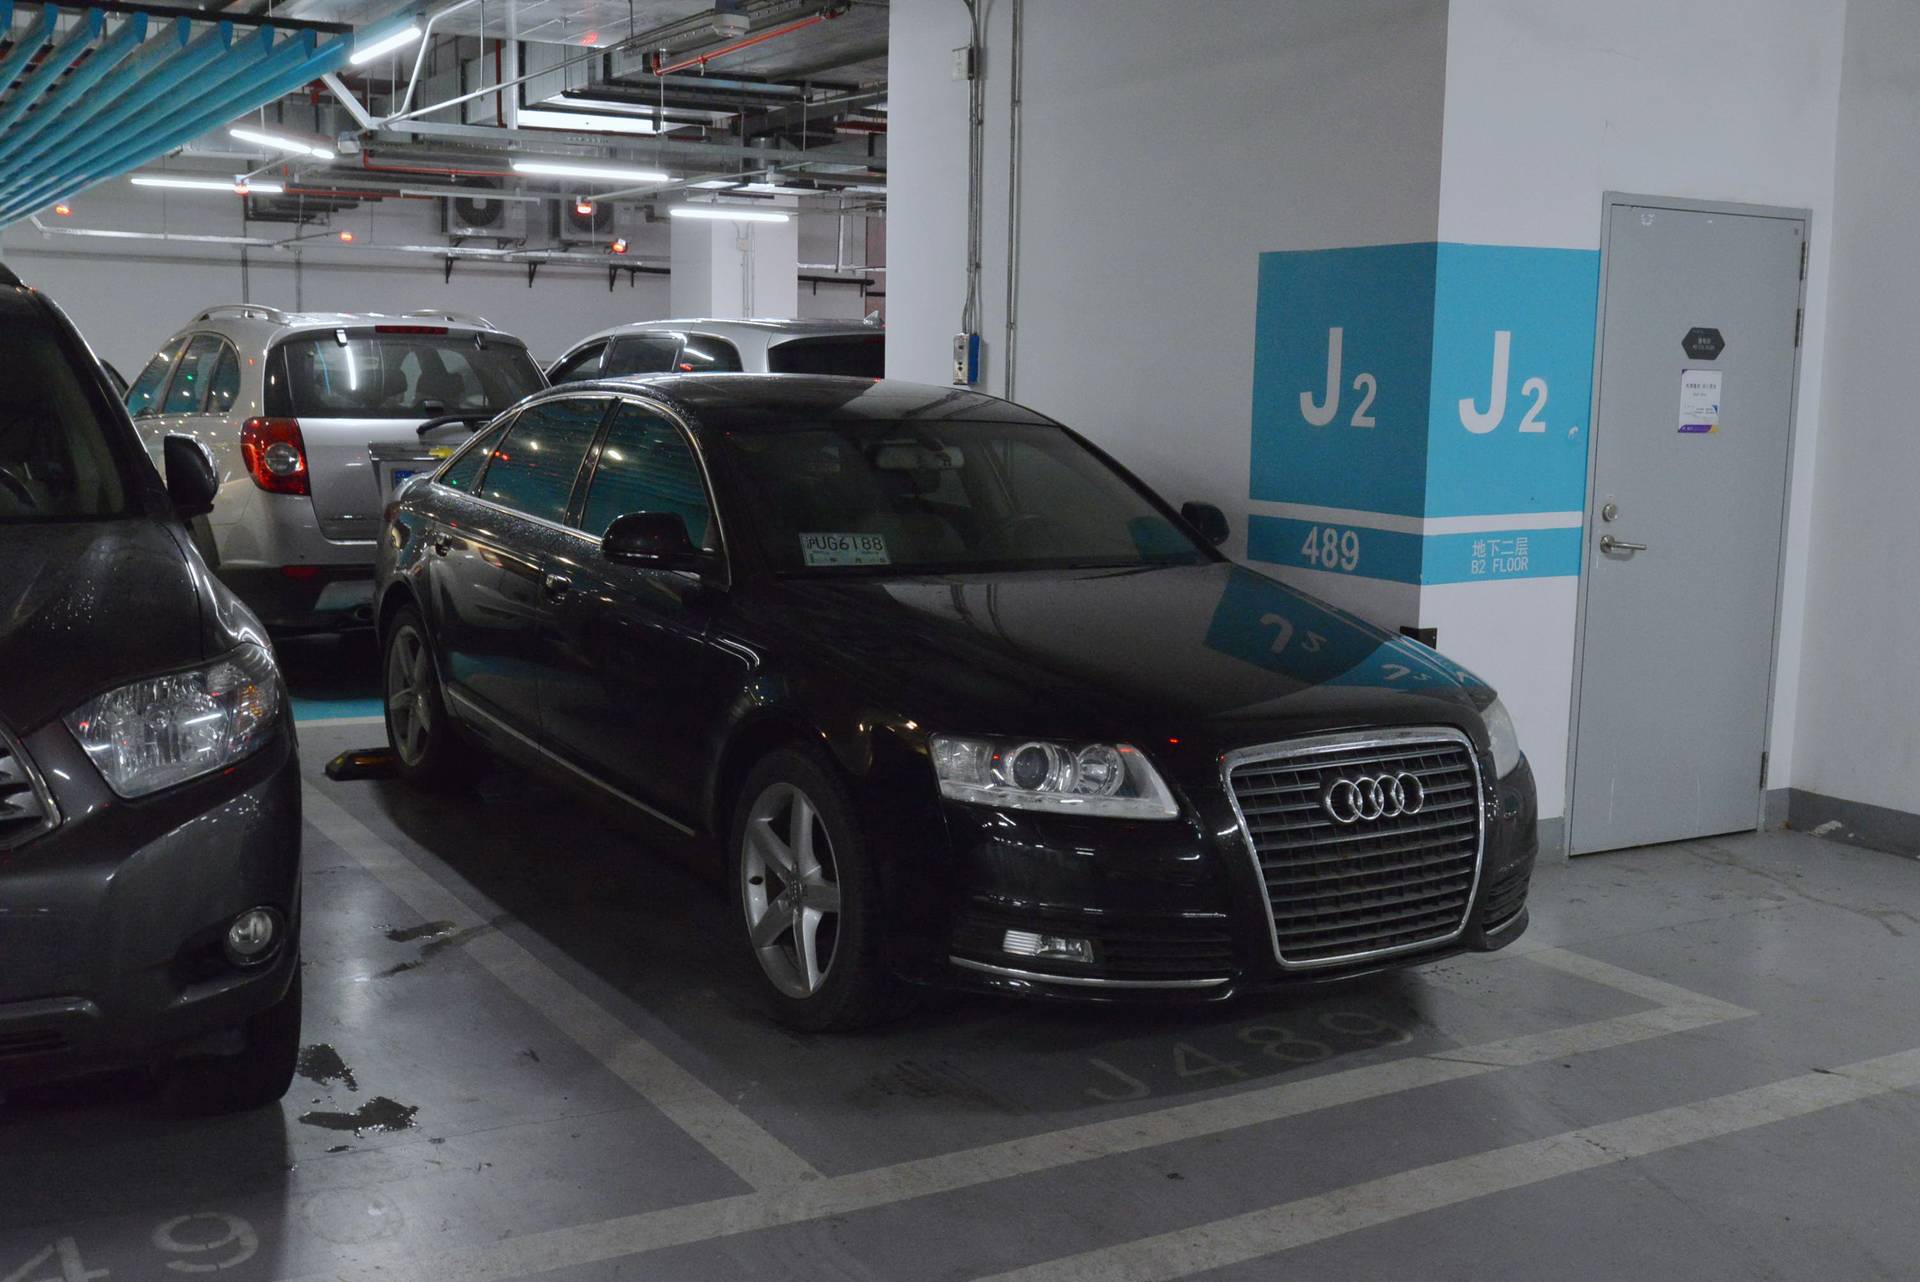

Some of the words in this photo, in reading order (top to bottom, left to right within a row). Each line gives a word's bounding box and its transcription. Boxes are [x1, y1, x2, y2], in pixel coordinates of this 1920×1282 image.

[1300, 327, 1377, 428] J2
[1458, 330, 1549, 434] J2
[1301, 526, 1360, 571] 489
[1471, 537, 1529, 559] 地下二层
[1471, 559, 1486, 575] B2
[1493, 556, 1529, 573] FLOOR
